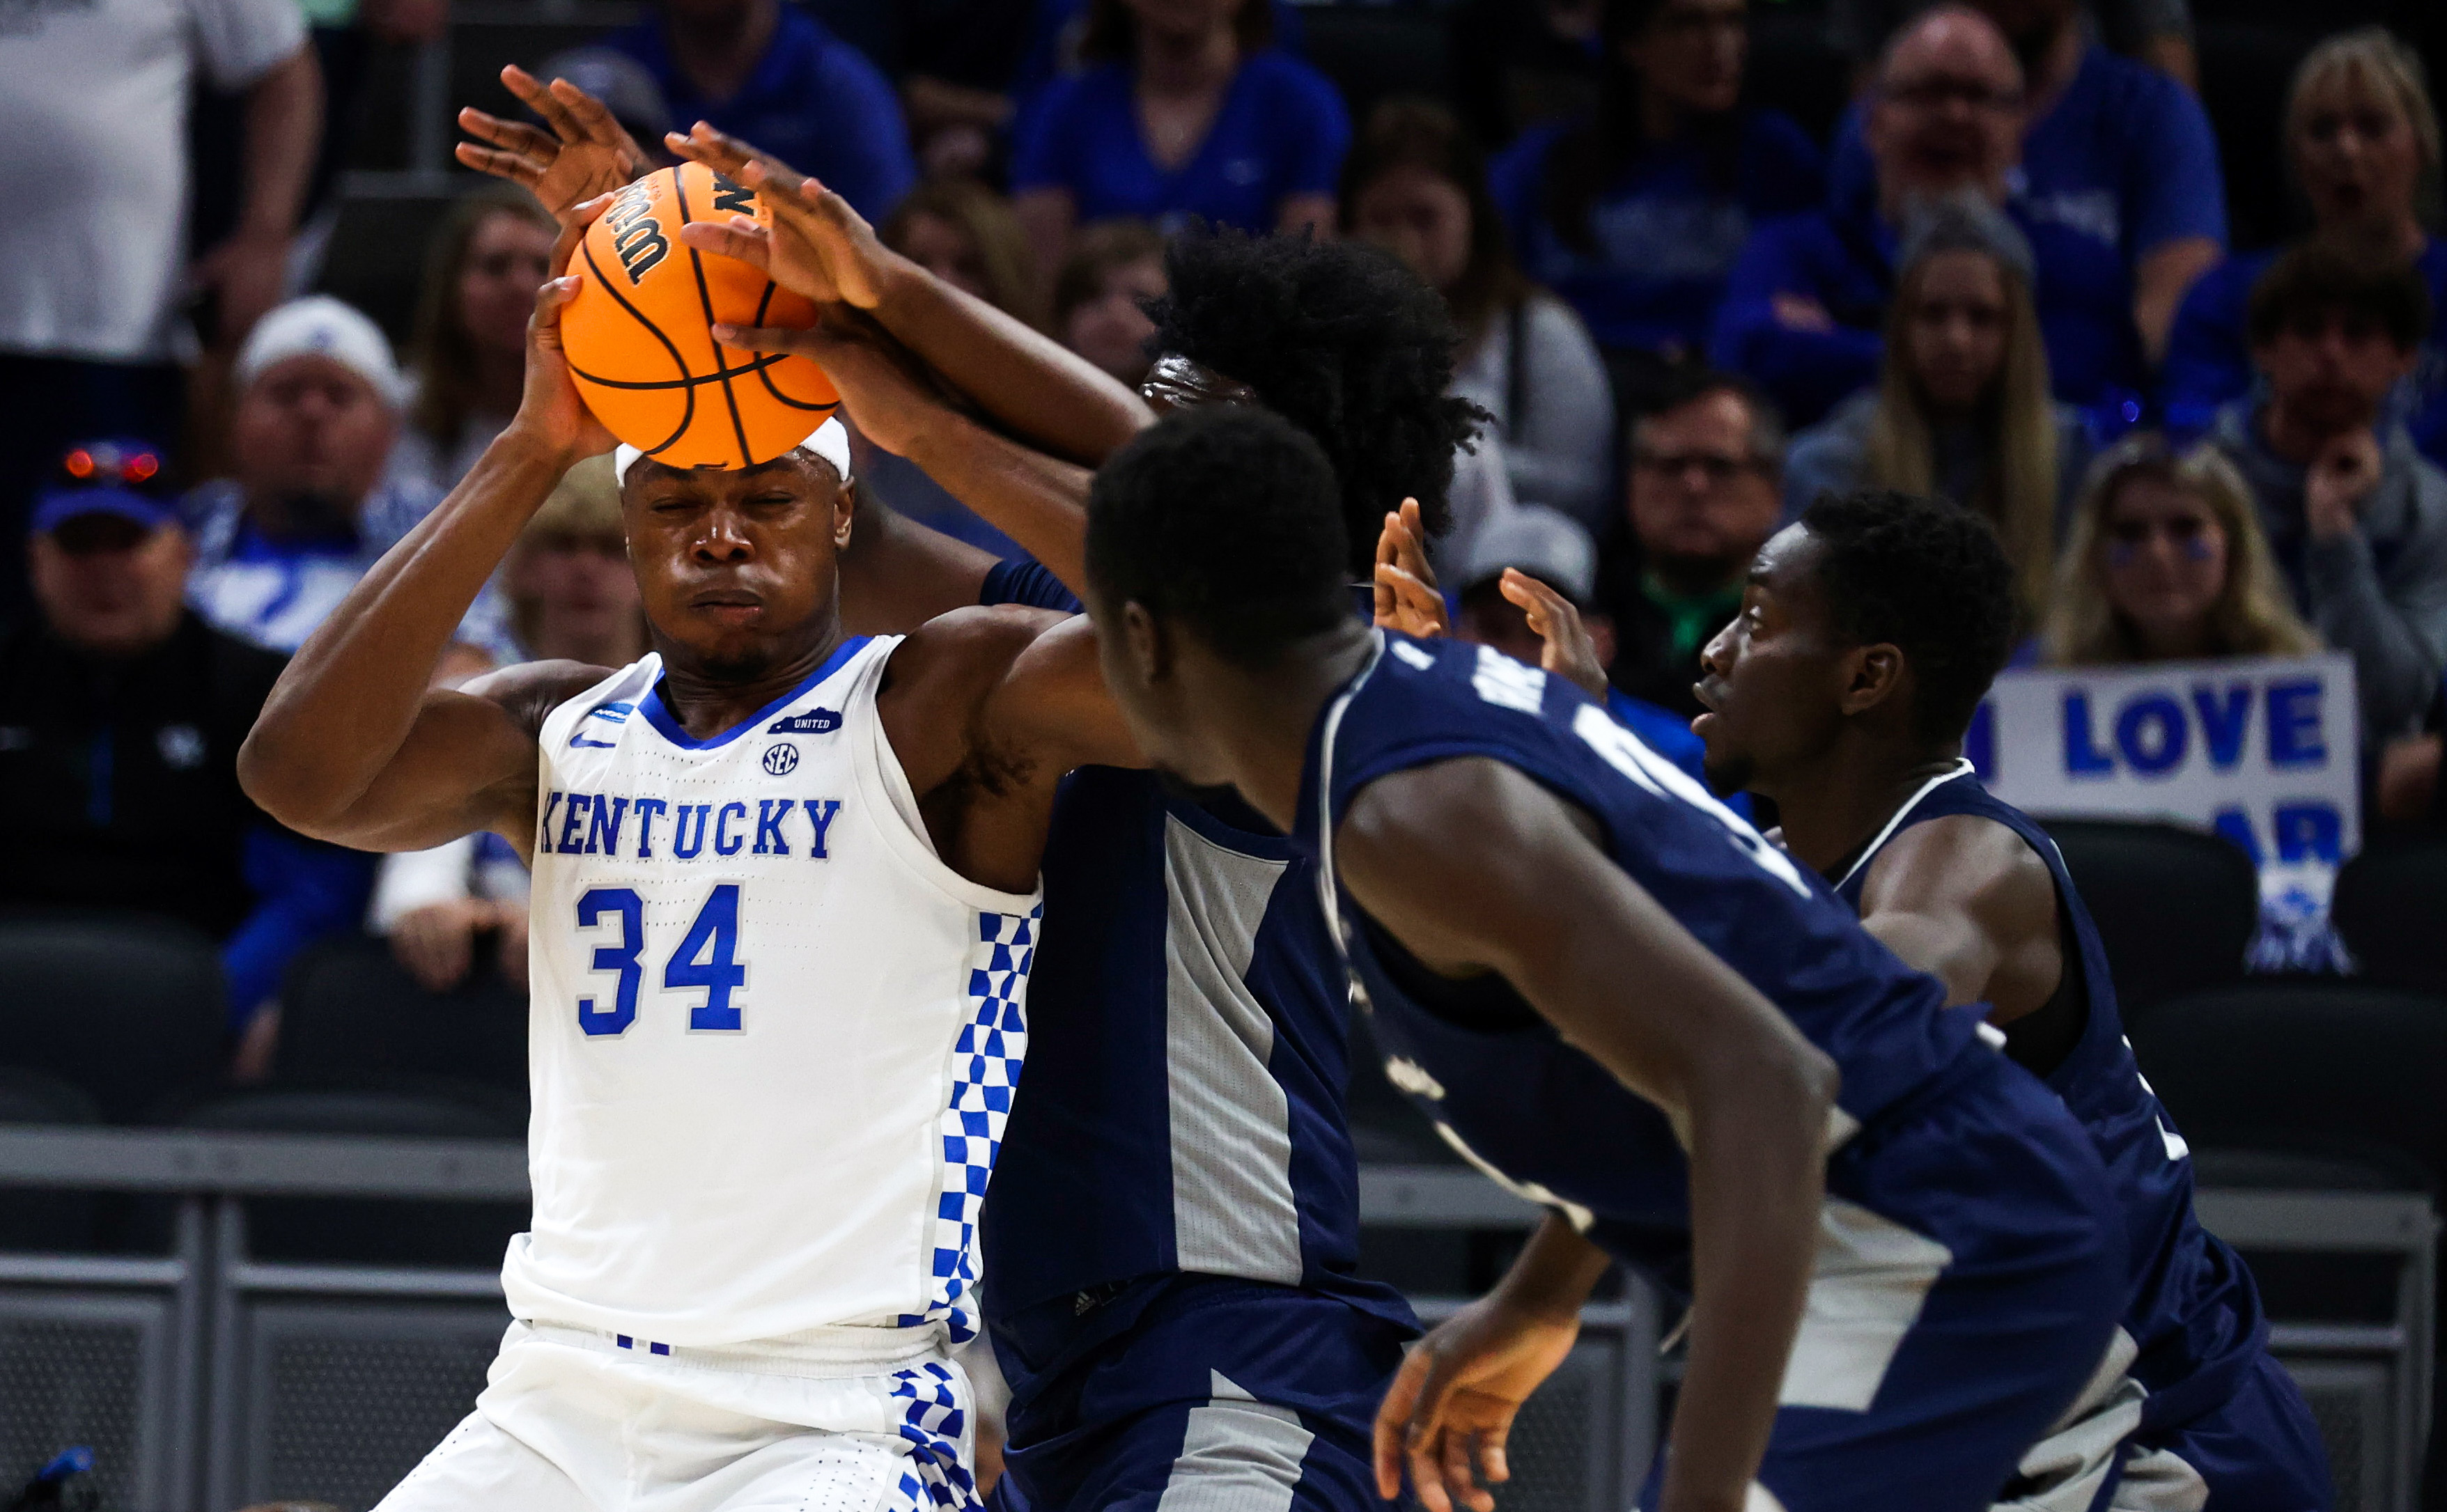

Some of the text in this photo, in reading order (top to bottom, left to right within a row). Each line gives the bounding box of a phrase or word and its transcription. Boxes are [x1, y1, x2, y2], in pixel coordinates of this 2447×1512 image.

[794, 719, 830, 729] UNITED
[2063, 678, 2329, 774] LOVE
[764, 745, 797, 774] SEC
[541, 791, 840, 859] KENTUCKY
[575, 883, 749, 1036] 34
